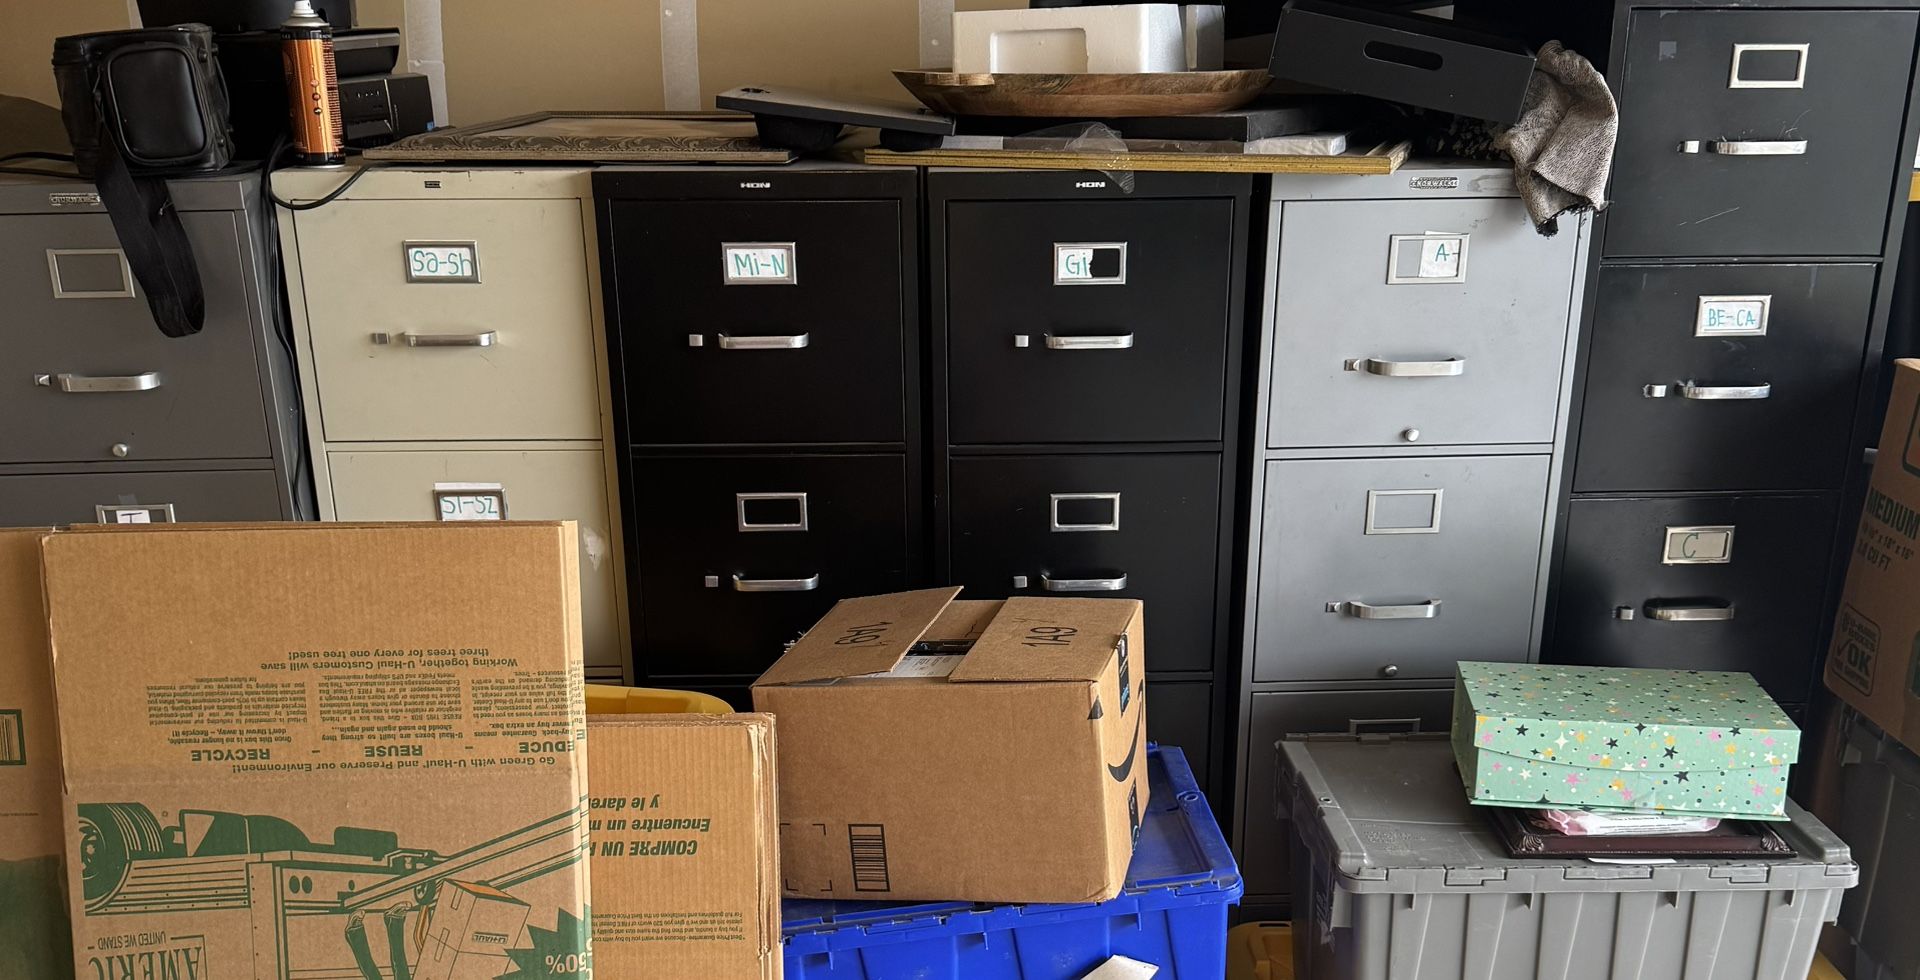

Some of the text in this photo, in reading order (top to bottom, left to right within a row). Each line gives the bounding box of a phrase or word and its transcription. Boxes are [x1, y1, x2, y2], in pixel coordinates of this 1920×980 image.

[734, 253, 786, 276] Mi-N
[1065, 252, 1088, 276] Gi
[1866, 487, 1920, 541] MEDIUM
[1682, 532, 1699, 559] C
[1020, 626, 1078, 647] 1A9
[288, 652, 319, 660] used!
[322, 651, 346, 660] tree
[373, 648, 404, 657] every
[407, 650, 423, 658] for
[426, 649, 456, 658] trees
[459, 649, 488, 658] three
[418, 658, 469, 669] together,
[472, 656, 518, 668] Working
[1846, 641, 1872, 678] OK
[289, 663, 308, 671] will
[312, 662, 373, 671] Customers
[376, 661, 415, 670] U-Haul
[181, 729, 208, 737] Recycle
[332, 725, 359, 733] again...
[543, 728, 571, 736] uy-back
[168, 736, 199, 745] reusable,
[201, 736, 223, 744] longer
[365, 745, 423, 757] REUSE
[519, 741, 575, 752] EDUCE
[191, 749, 270, 762] RECYCLE
[397, 761, 418, 769] and
[471, 759, 496, 767] with
[499, 758, 535, 766] Green
[539, 757, 555, 765] Go
[232, 764, 312, 773] Environment!
[339, 762, 393, 771] Preserve
[632, 798, 646, 811] le
[650, 794, 660, 808] y
[607, 820, 627, 831] un
[632, 819, 710, 832] Encuentre
[601, 842, 624, 856] UN
[630, 840, 698, 856] COMPRE
[97, 931, 166, 950] UNITED WE STAND
[473, 934, 507, 944] U-HAUL
[88, 946, 201, 980] AMERIC
[546, 952, 588, 974] 50%
